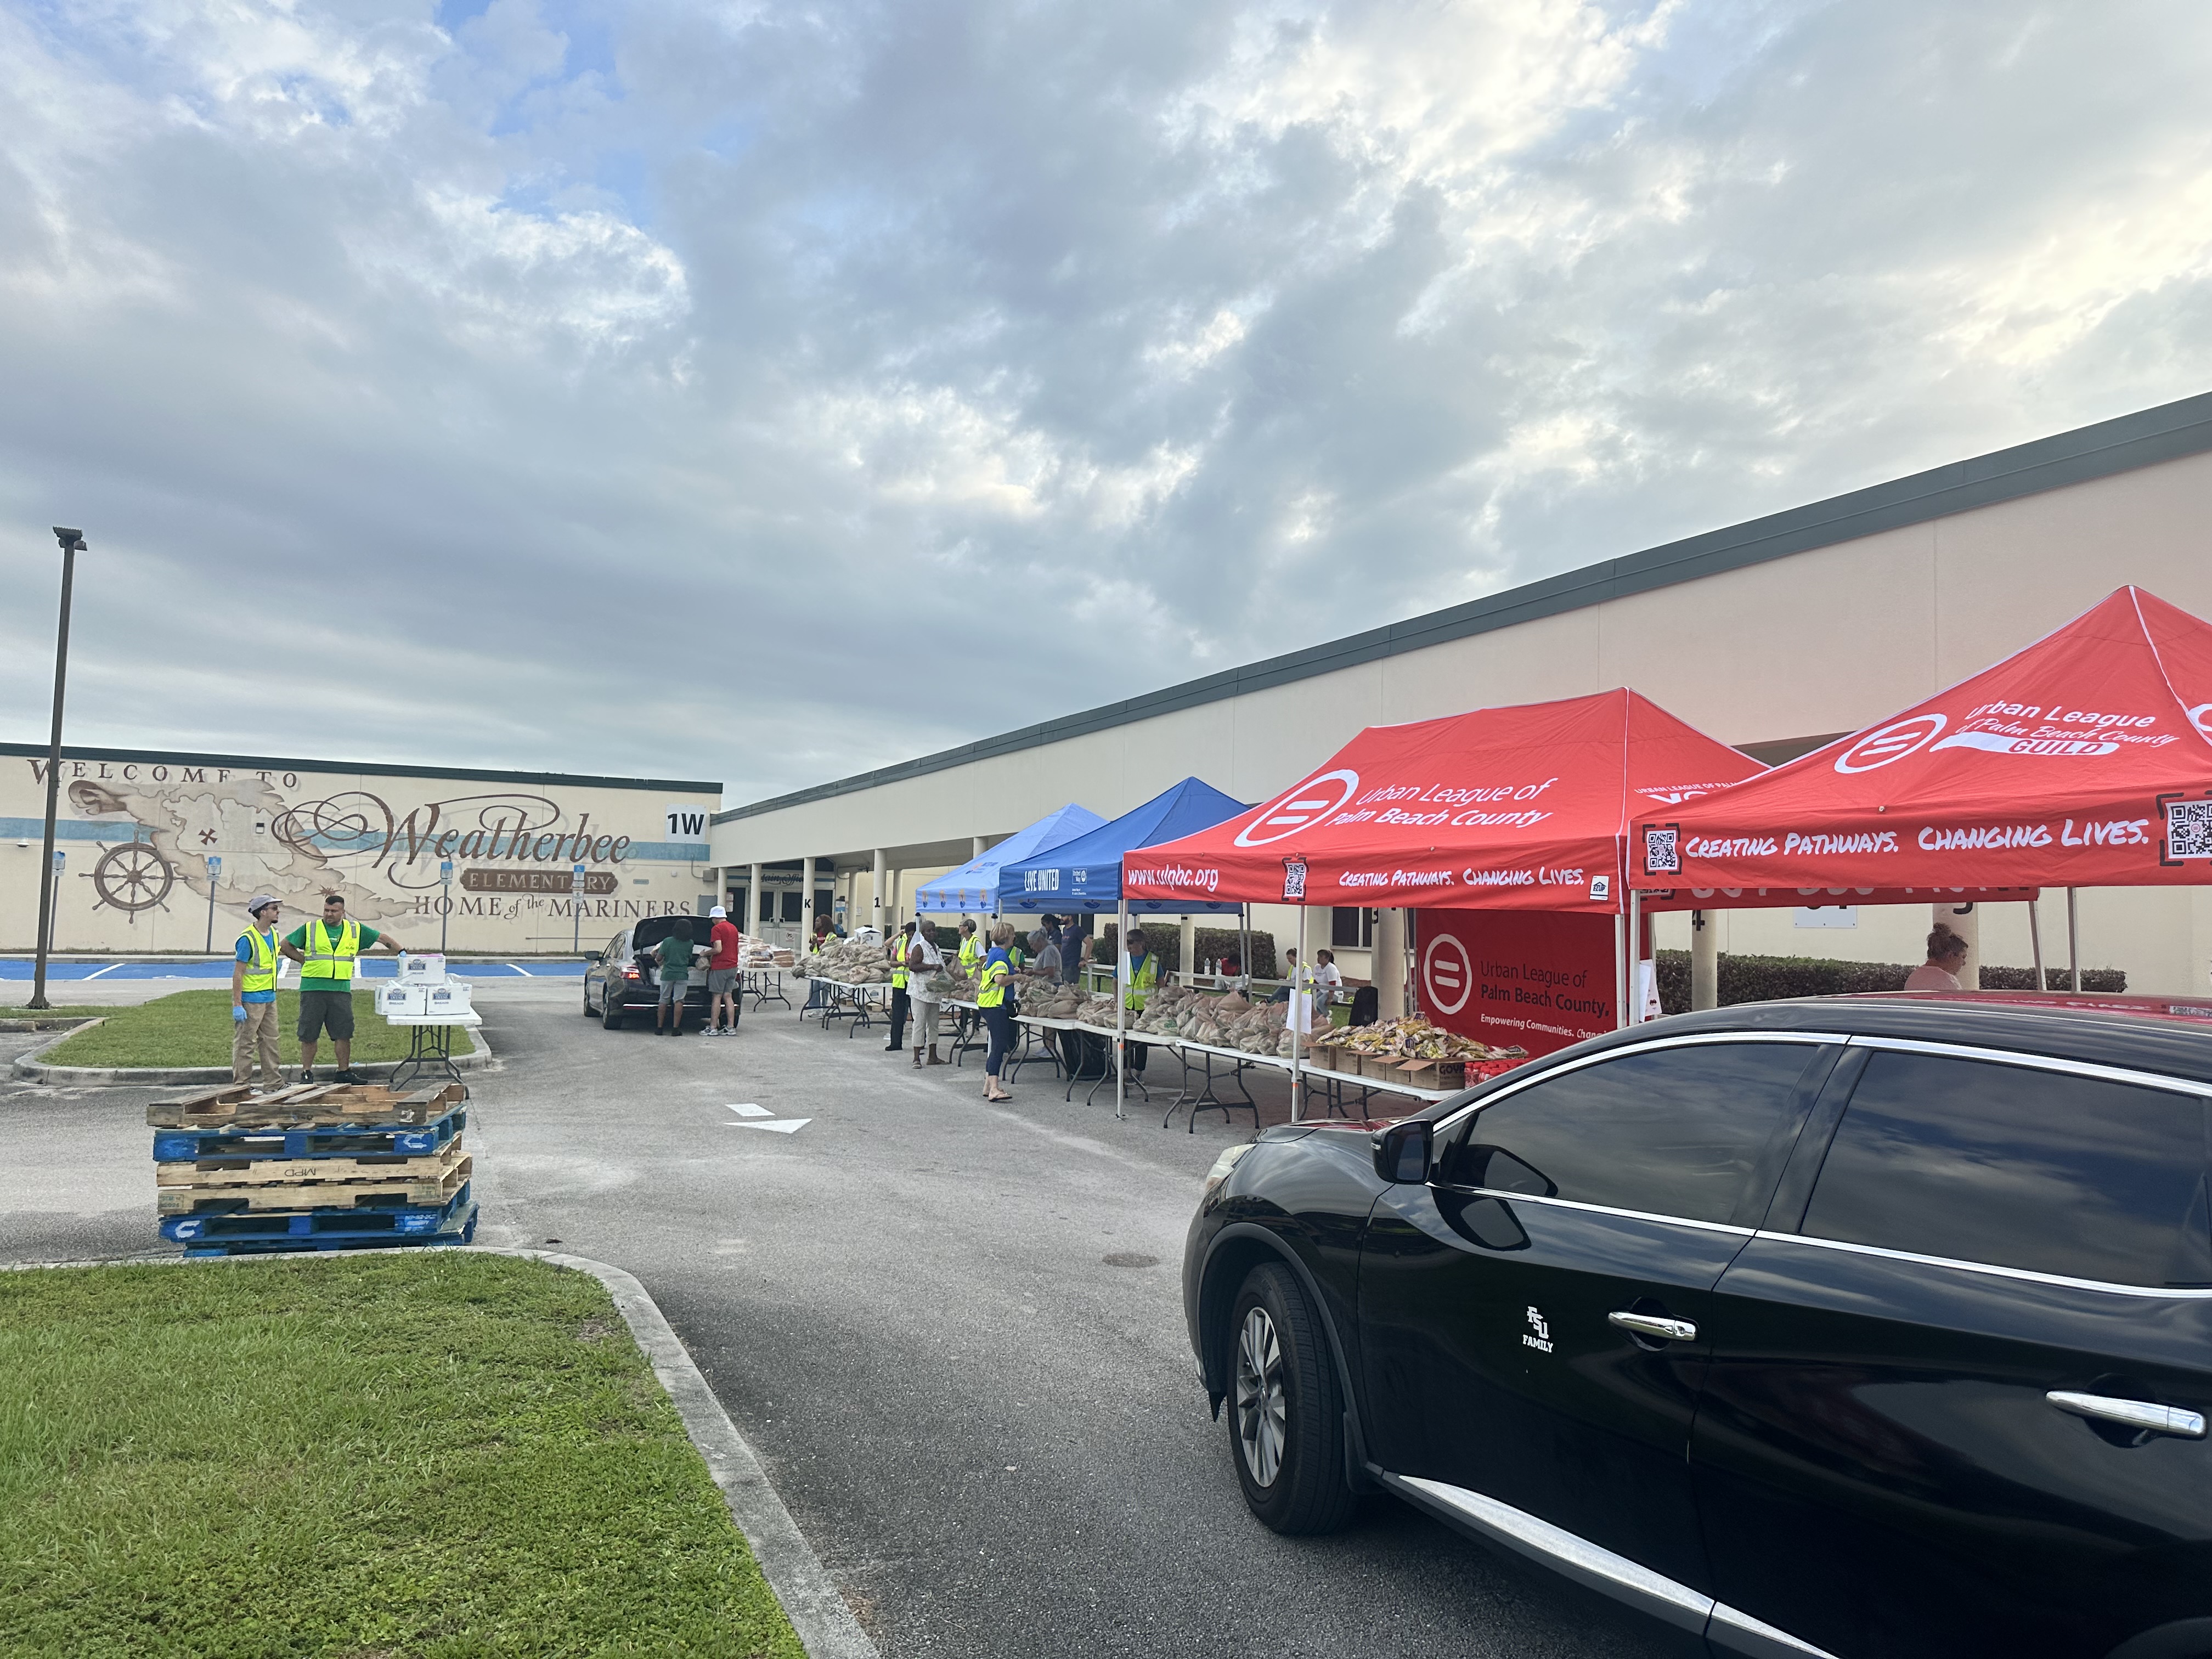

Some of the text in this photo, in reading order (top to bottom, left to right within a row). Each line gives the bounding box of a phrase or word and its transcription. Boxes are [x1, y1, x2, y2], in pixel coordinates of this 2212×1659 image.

[1964, 701, 2155, 728] Urban League
[1976, 718, 2029, 735] Palm
[2030, 726, 2099, 741] Beach
[2098, 730, 2180, 747] County
[2008, 740, 2103, 754] GUILD
[256, 771, 297, 788] TO
[1666, 783, 1704, 792] LEAGUE
[1356, 777, 1559, 807] Urban League of
[668, 813, 704, 835] 1W
[1324, 808, 1554, 828] Palm Beach County
[273, 792, 630, 878] Weatherbee
[1685, 819, 2149, 858] CREATING PATHWAYS. CHANGING LIVES.
[469, 873, 614, 890] ELEMENTRY
[1024, 868, 1059, 891] LIVE UNITED
[1128, 864, 1218, 892] www.ulpbc.org
[1339, 866, 1584, 887] CREATING PATHWAYS. CHANGING LIVES.
[413, 893, 691, 919] HOME of the MARINERS
[804, 898, 811, 908] K
[874, 896, 881, 908] 1
[1481, 961, 1588, 988] Urban League of
[1481, 984, 1510, 1002] Palm
[1515, 987, 1551, 1007] Beach
[1481, 1014, 1606, 1039] Empowering Communities. Chan
[1527, 1306, 1549, 1339] FSU
[1523, 1334, 1554, 1353] FAMILY
